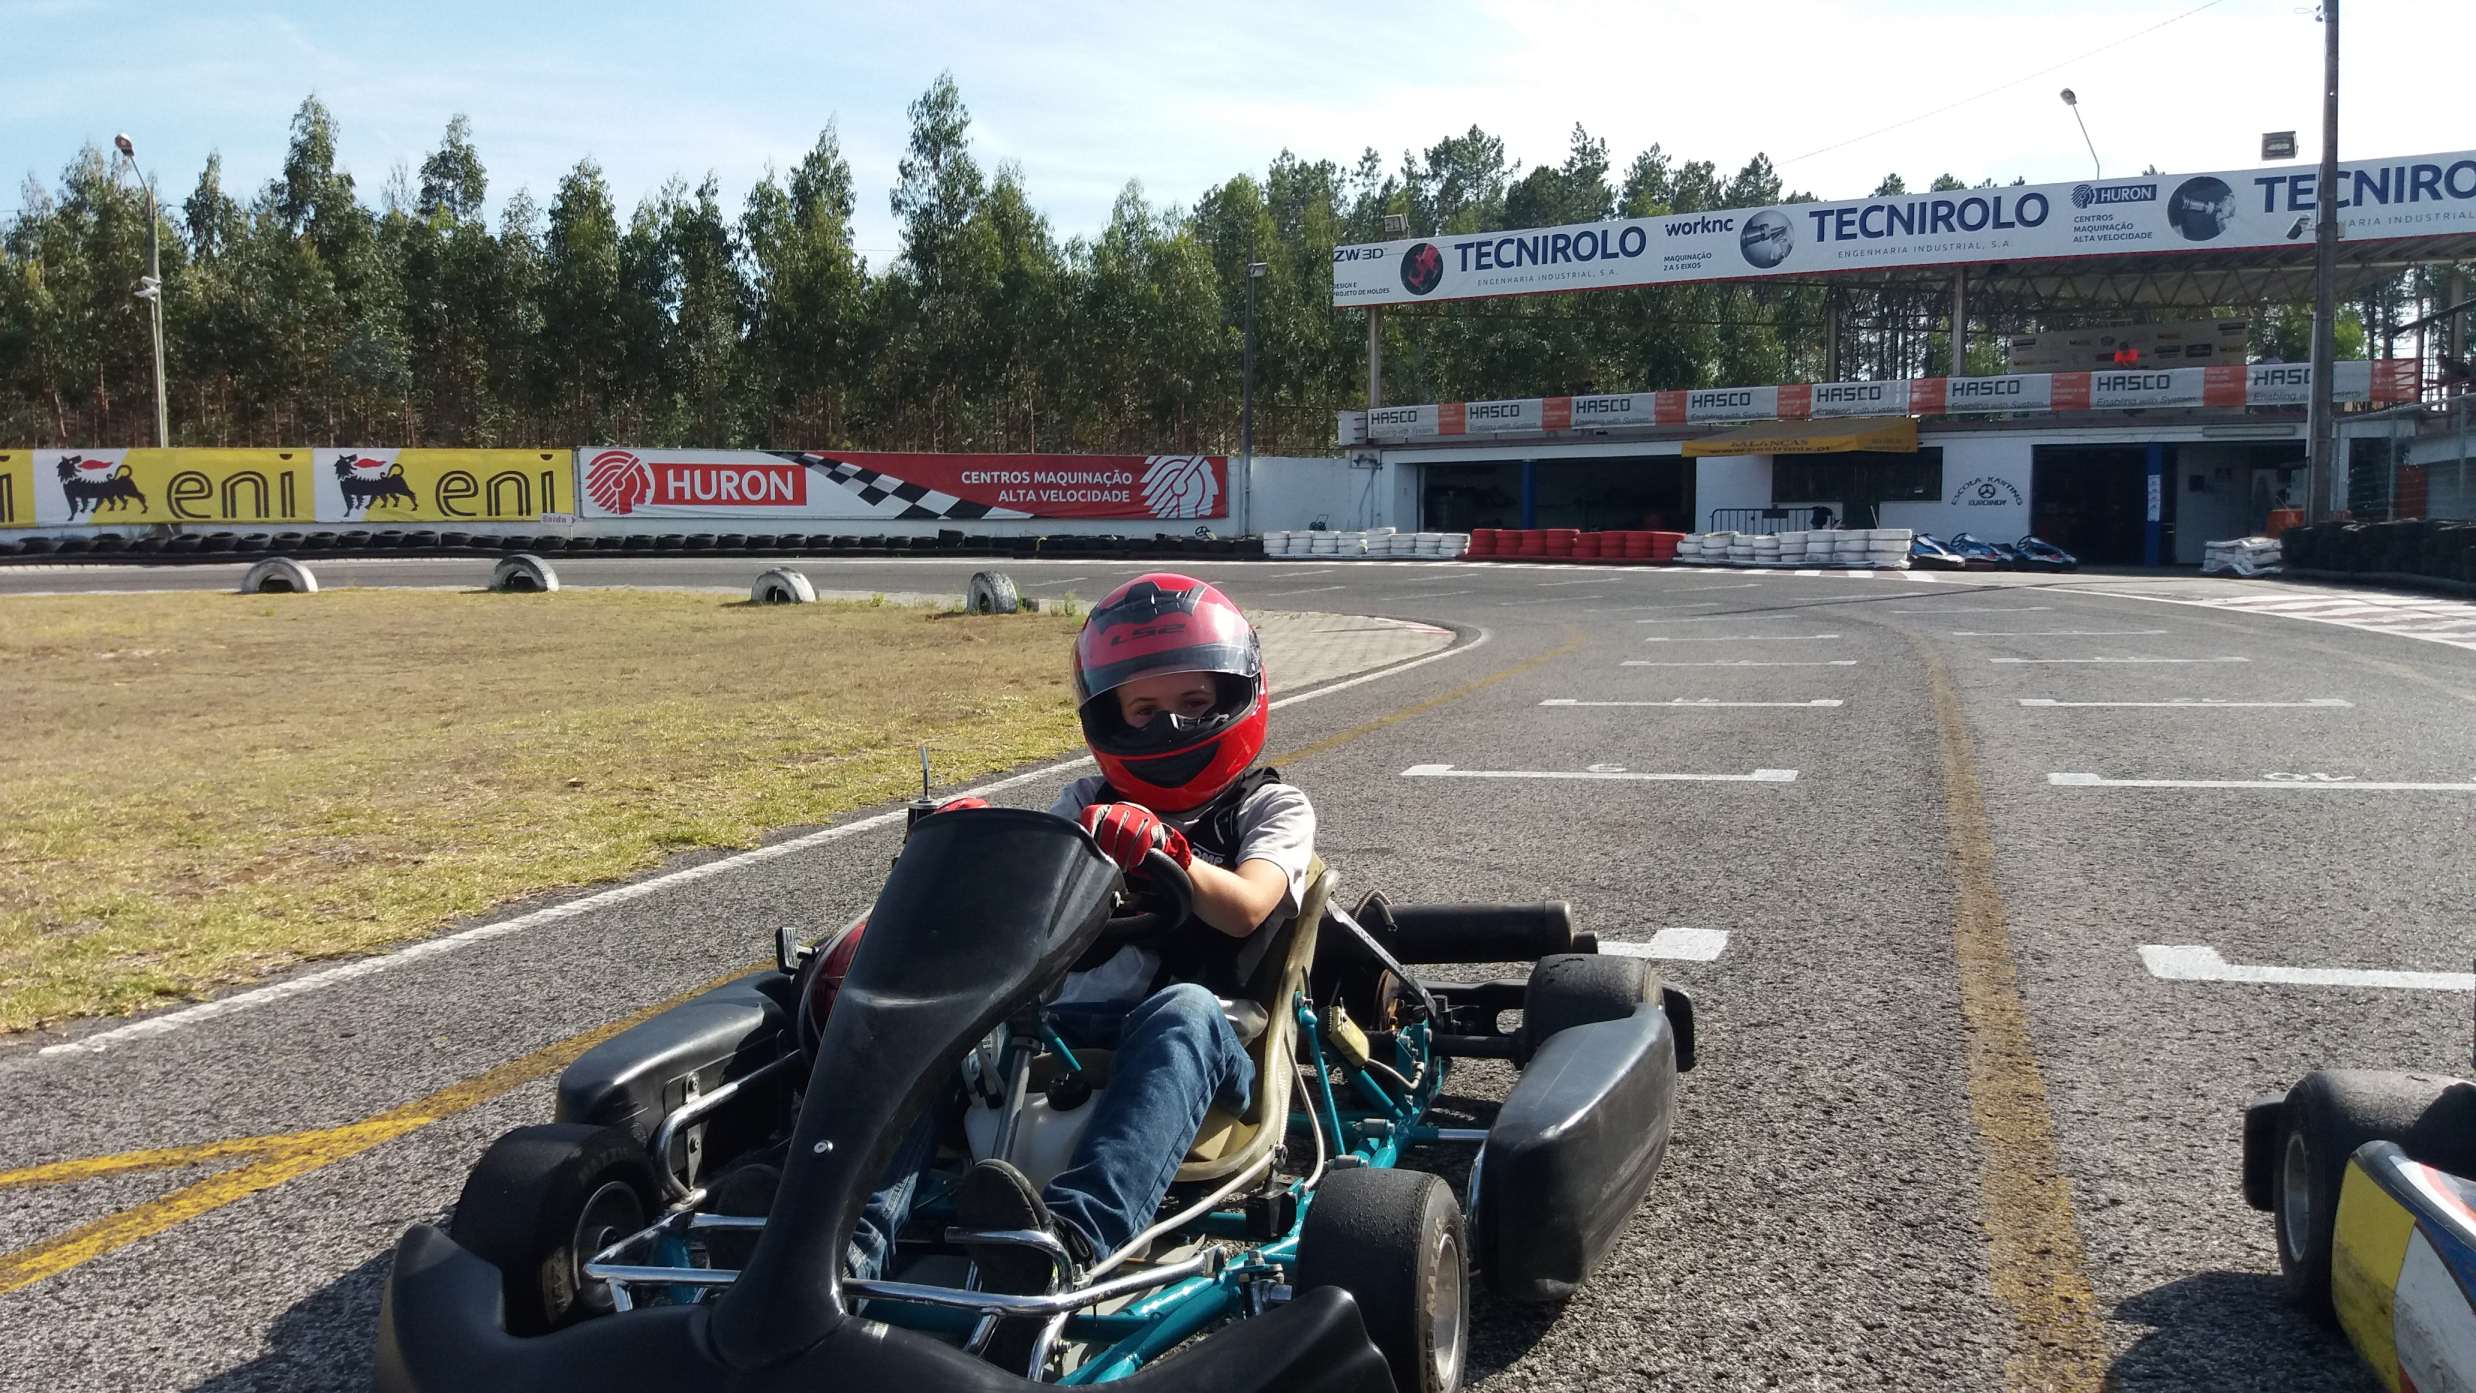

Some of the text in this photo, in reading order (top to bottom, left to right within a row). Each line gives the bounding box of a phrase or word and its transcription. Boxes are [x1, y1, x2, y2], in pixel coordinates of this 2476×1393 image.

[2100, 187, 2152, 201] HURON
[1809, 192, 2049, 242] TECNIROLO
[2073, 214, 2114, 223] CENTROS
[1664, 215, 1734, 237] worknc
[2073, 221, 2134, 233] MAQUINAÇÃO
[2073, 231, 2153, 243] ALTA VELOCIDADE
[1454, 226, 1647, 272] TECNIROLO
[1663, 252, 1712, 262] MAQUINAÇÃO
[1838, 246, 1908, 259] ENGENHARIA
[1680, 262, 1702, 270] EIXOS
[1477, 275, 1535, 287] ENGENHARIA
[1358, 289, 1366, 297] DE
[2097, 375, 2170, 391] HASCO
[2254, 369, 2311, 386] HAS
[1817, 386, 1881, 402] HASCO
[1952, 380, 2020, 397] HASCO
[1576, 399, 1631, 413] HASCO
[1692, 392, 1750, 408] HASCO
[1371, 411, 1417, 424] HASCO
[1470, 405, 1520, 419] HASCO
[167, 453, 296, 519] eni
[435, 454, 556, 517] eni
[667, 468, 793, 500] HURON
[961, 470, 1133, 487] CENTROS MAQUINAÇÃO
[998, 489, 1131, 502] ALTA VELOCIDADE
[1110, 623, 1186, 647] LS2
[1191, 847, 1224, 866] OMP
